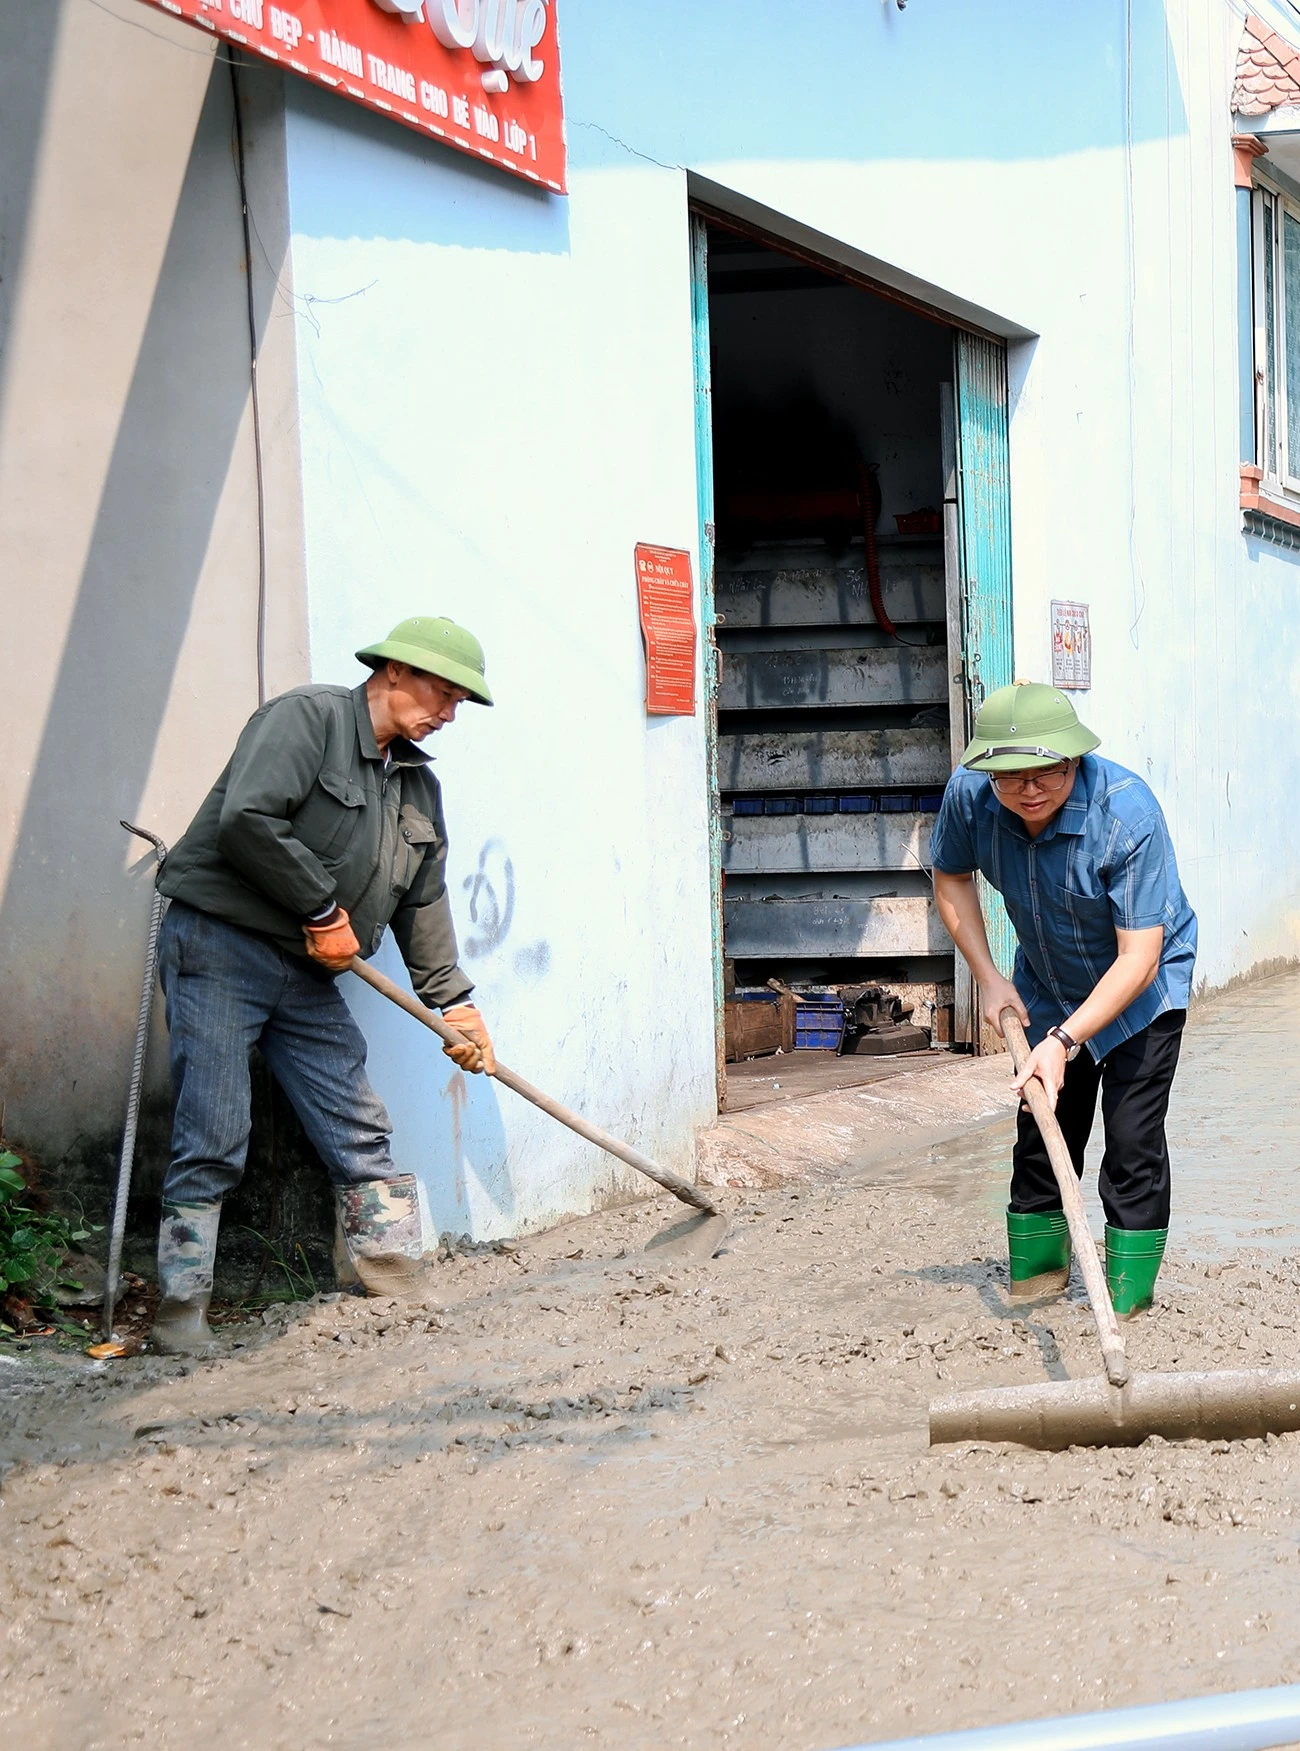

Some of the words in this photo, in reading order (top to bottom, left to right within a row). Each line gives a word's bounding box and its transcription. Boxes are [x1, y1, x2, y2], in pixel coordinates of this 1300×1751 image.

[270, 5, 303, 51] ĐẸP
[319, 29, 364, 79] HÀNH
[367, 53, 417, 104] TRANG
[420, 80, 449, 119] CHO
[452, 94, 471, 130] BÉ
[473, 104, 499, 143] VÀO
[503, 119, 527, 155] LỚP
[529, 133, 537, 161] 1
